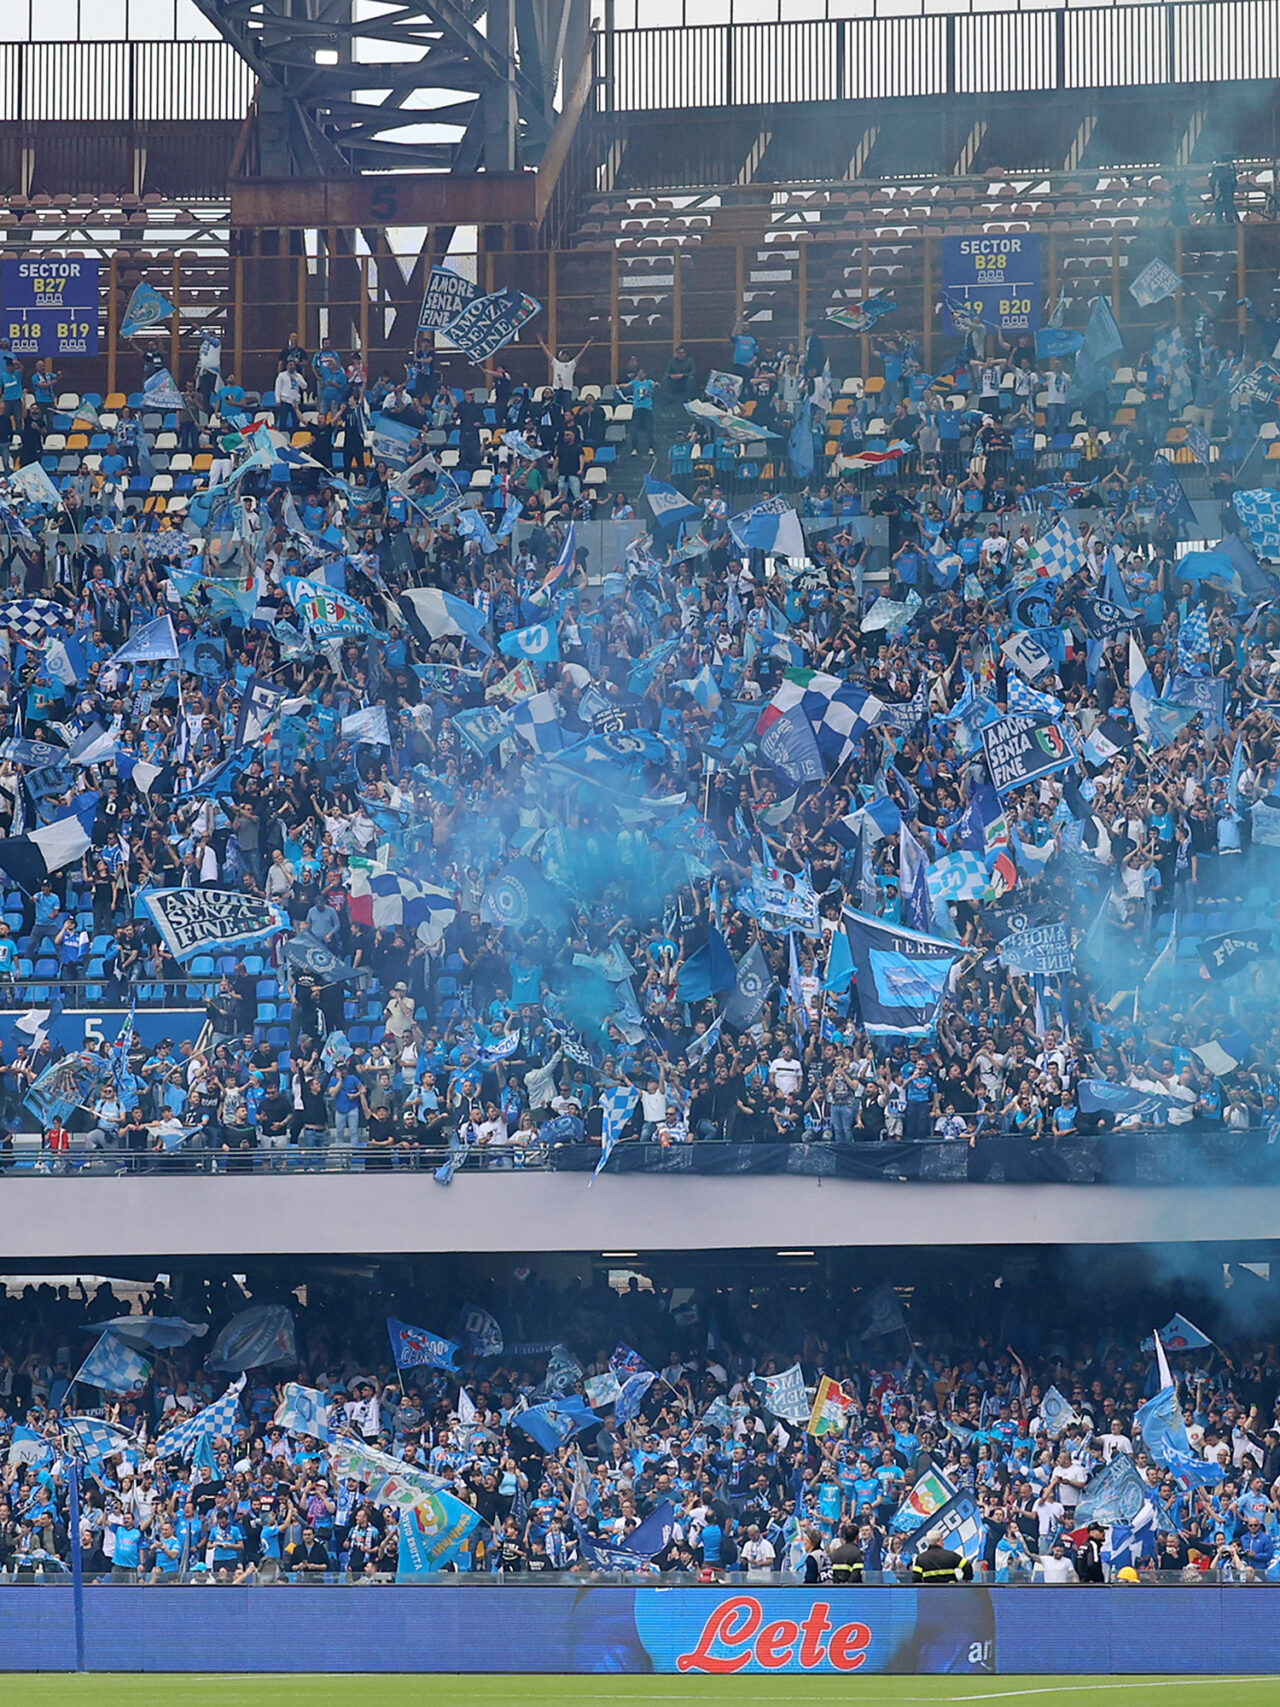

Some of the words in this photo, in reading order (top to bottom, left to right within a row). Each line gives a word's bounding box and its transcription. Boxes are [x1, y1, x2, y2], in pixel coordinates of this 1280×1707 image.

[371, 186, 397, 220] 5
[960, 239, 1022, 254] SECTOR
[19, 263, 81, 277] SECTOR
[975, 255, 1007, 269] B28
[33, 278, 66, 292] B27
[430, 275, 476, 298] AMORE
[425, 292, 463, 312] SENZA
[999, 299, 1031, 314] B20
[9, 323, 42, 338] B18
[57, 323, 90, 338] B19
[421, 309, 450, 327] FINE
[458, 298, 513, 349] SENZA
[469, 318, 513, 360] FINE
[1014, 635, 1047, 665] 19
[988, 717, 1037, 747] AMORE
[991, 737, 1033, 767] SENZA
[995, 756, 1027, 785] FINE
[167, 903, 257, 929] SENZA
[175, 919, 239, 948] FINE
[85, 1018, 105, 1046] 5
[915, 1497, 976, 1555] DEGO
[677, 1596, 871, 1673] Lete
